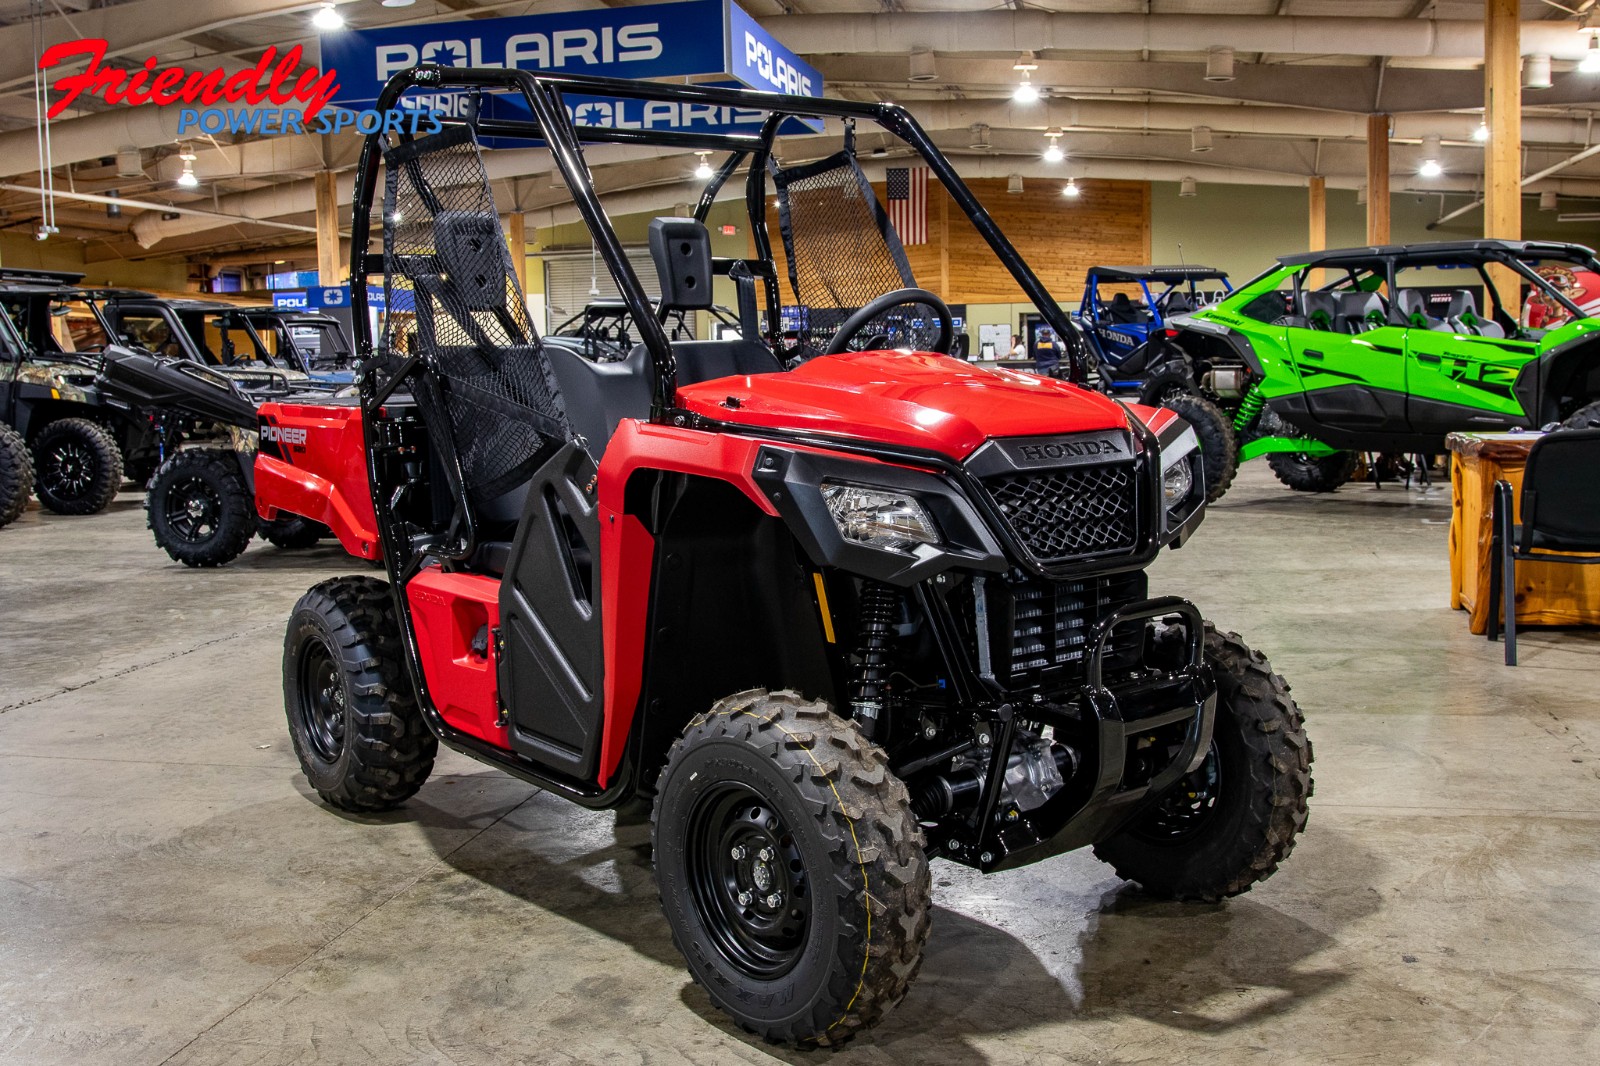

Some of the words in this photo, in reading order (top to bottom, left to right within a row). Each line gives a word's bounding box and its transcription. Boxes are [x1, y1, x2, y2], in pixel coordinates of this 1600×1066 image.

[376, 22, 663, 81] POLARIS
[745, 31, 812, 97] POLARIS
[565, 101, 770, 129] OLARIS
[1202, 312, 1245, 326] Kawasaki
[1098, 327, 1135, 347] HONDA
[260, 425, 307, 445] PIONEER
[1019, 439, 1122, 461] HONDA
